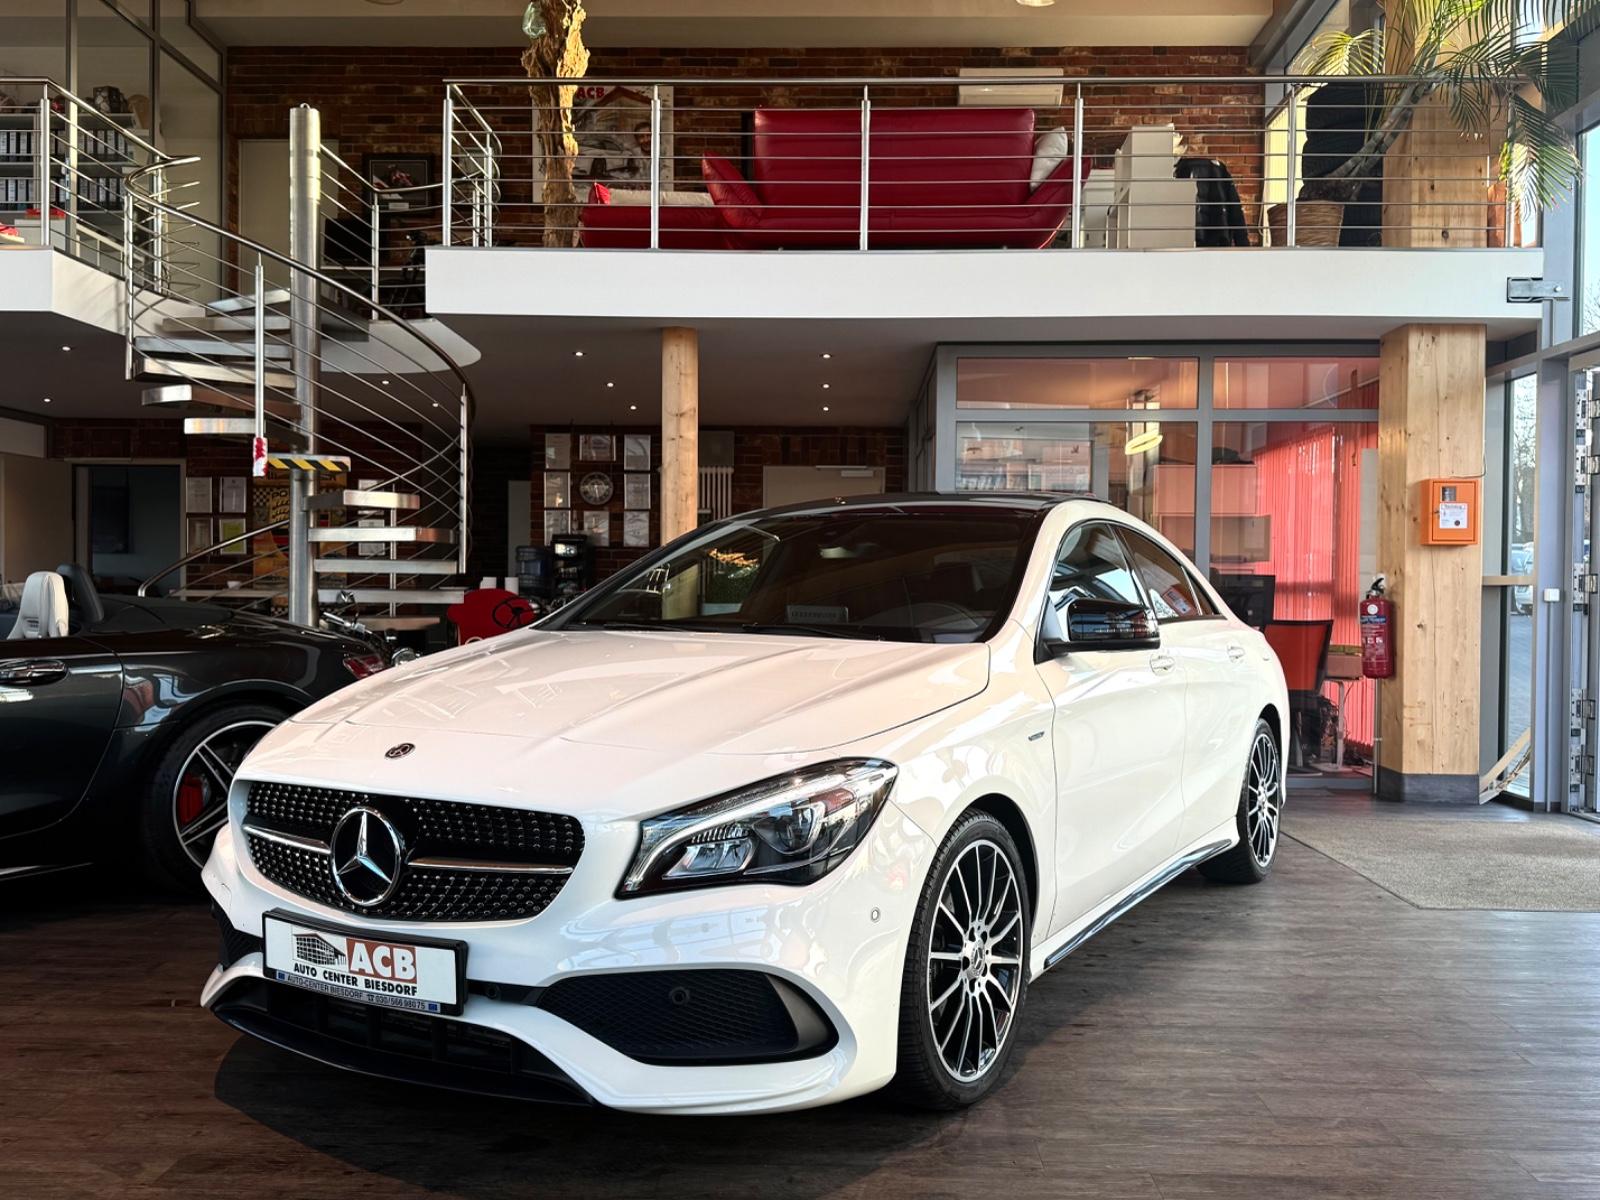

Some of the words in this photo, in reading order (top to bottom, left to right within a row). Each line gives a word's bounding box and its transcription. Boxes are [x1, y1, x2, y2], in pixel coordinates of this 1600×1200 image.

[576, 87, 605, 99] ACB
[349, 941, 416, 980] ACB
[294, 962, 318, 978] AUTO
[323, 970, 358, 987] CENTER
[364, 980, 418, 996] BIESDORF
[330, 985, 363, 999] BIESDORF
